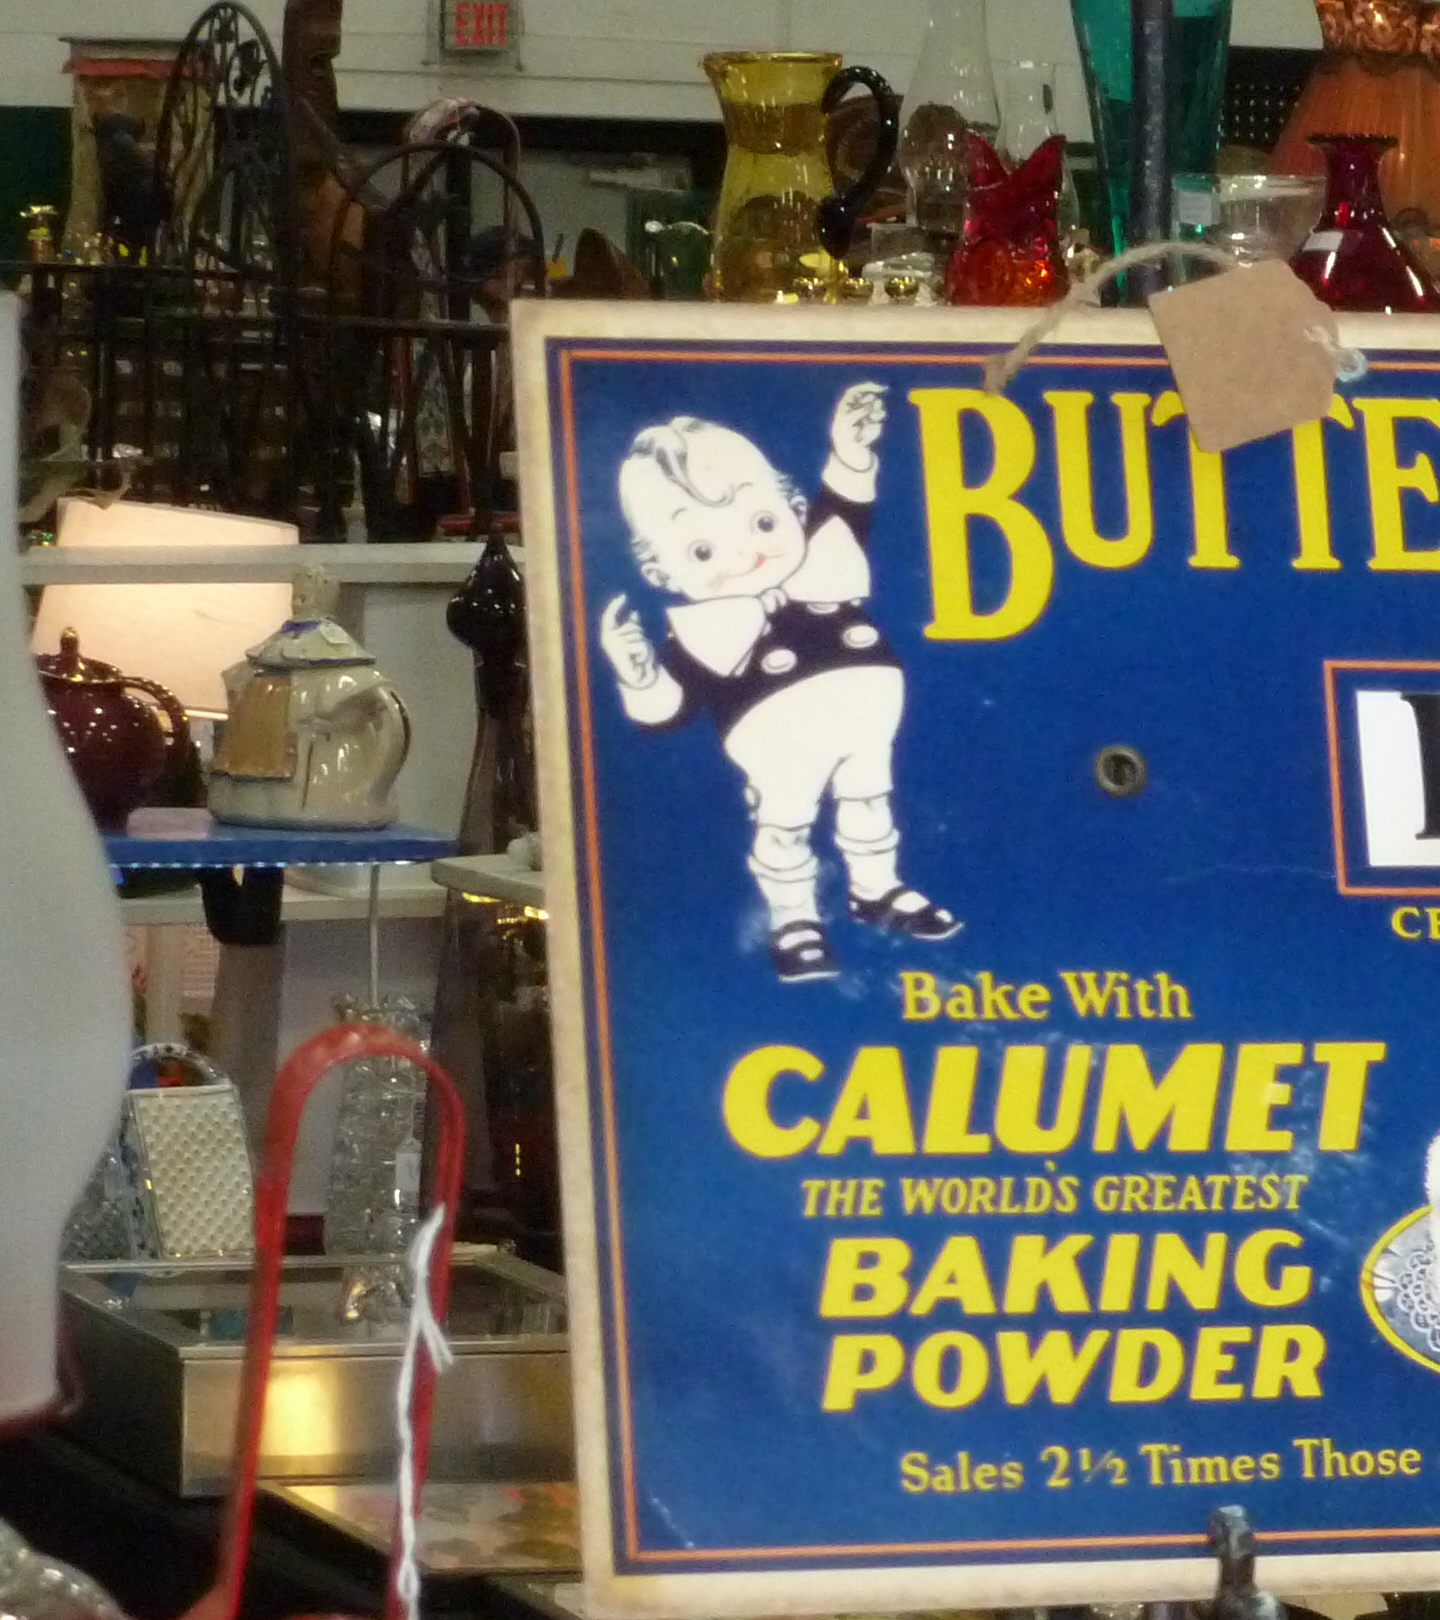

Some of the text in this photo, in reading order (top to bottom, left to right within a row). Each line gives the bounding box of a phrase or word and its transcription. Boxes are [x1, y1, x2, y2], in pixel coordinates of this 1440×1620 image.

[455, 3, 507, 45] EXIT
[900, 970, 1193, 1021] Bake With
[722, 1042, 1387, 1159] CALUMET
[802, 1160, 1310, 1217] THE WORLD'S GREATEST
[818, 1228, 1312, 1318] BAKING
[821, 1323, 1327, 1412] POWDER
[900, 1449, 1024, 1493] Sales
[1140, 1441, 1281, 1485] Times
[1293, 1438, 1422, 1480] Those
